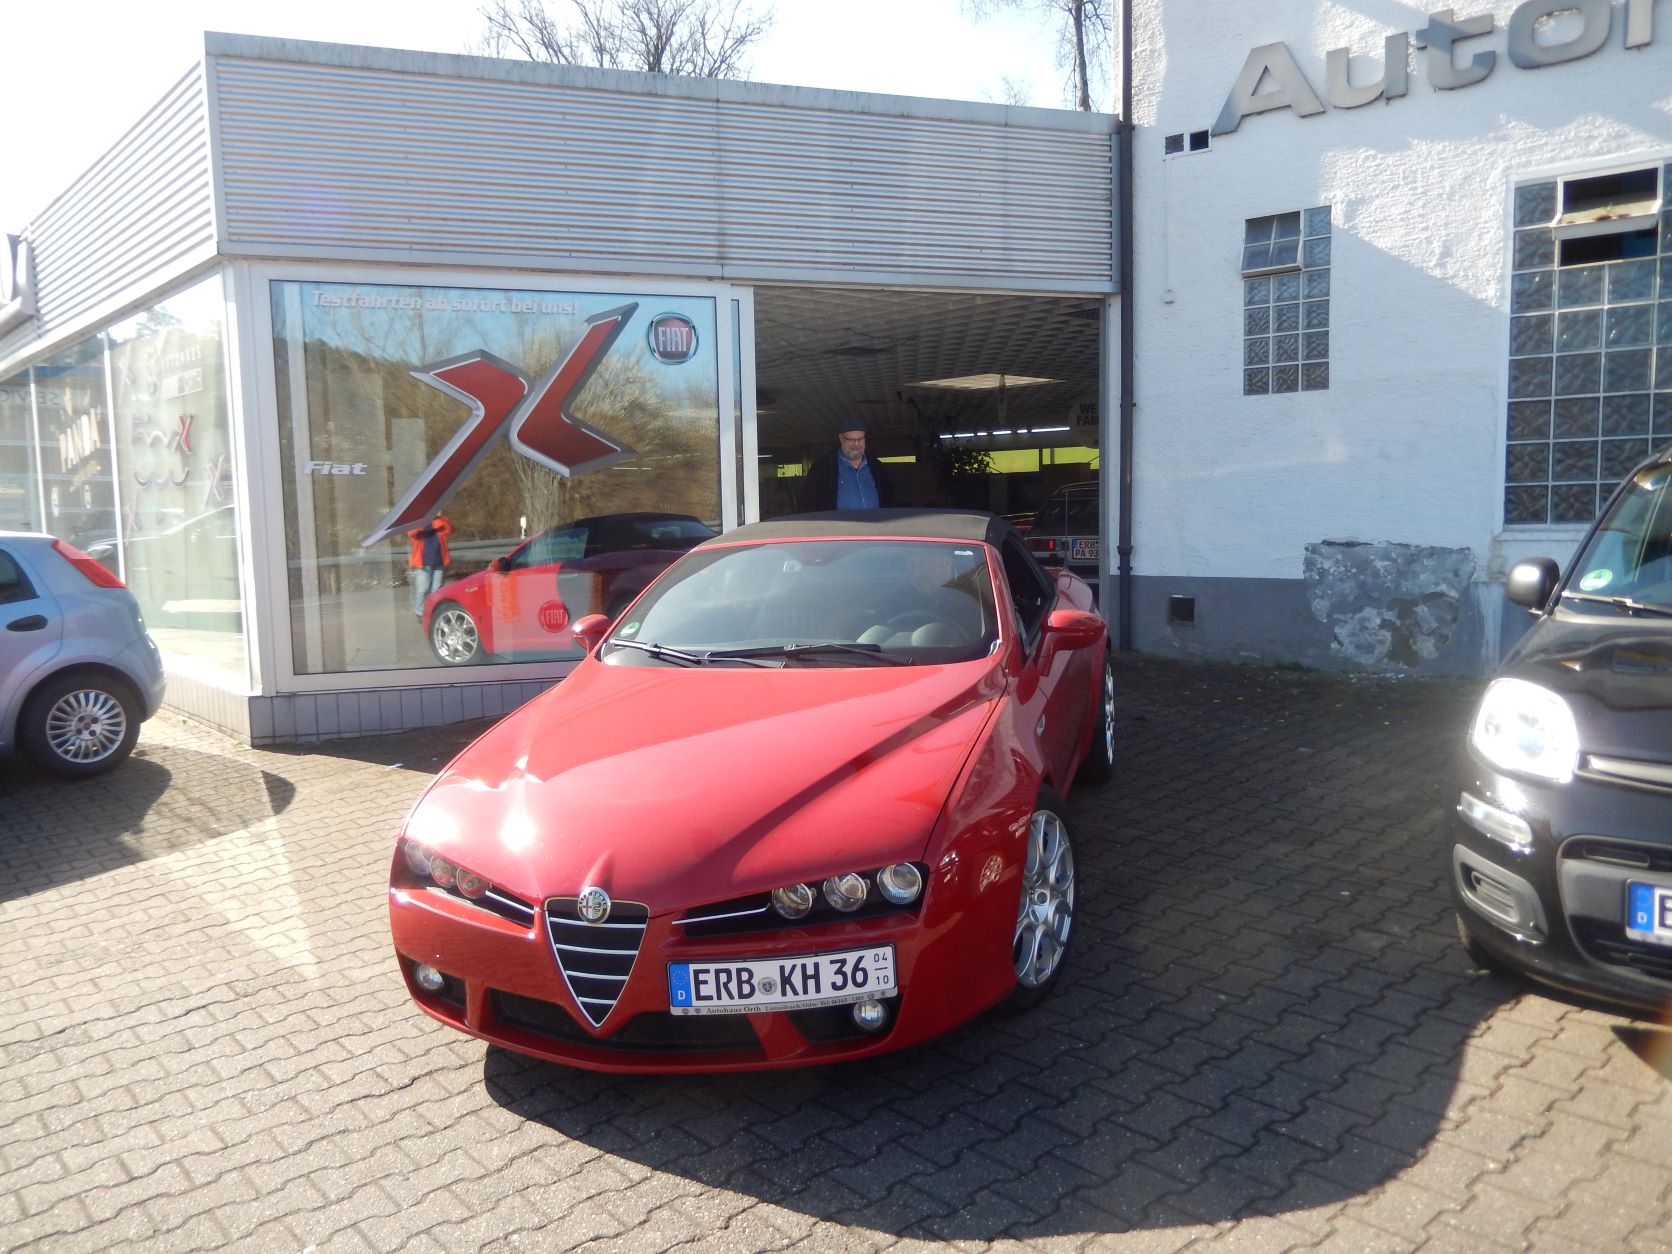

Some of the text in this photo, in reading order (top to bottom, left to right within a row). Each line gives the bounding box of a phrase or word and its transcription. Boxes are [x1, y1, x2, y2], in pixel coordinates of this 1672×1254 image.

[312, 290, 577, 315] Testfahrten ab sofort bei uns!
[658, 327, 689, 351] FIAT
[303, 460, 369, 475] Fiat
[545, 609, 564, 625] FIAT
[1637, 911, 1648, 924] D
[873, 951, 888, 963] 04
[677, 955, 869, 1001] D ERB KH 36
[876, 974, 889, 985] 10
[706, 1006, 742, 1014] Autohaus
[743, 1005, 762, 1013] Orth
